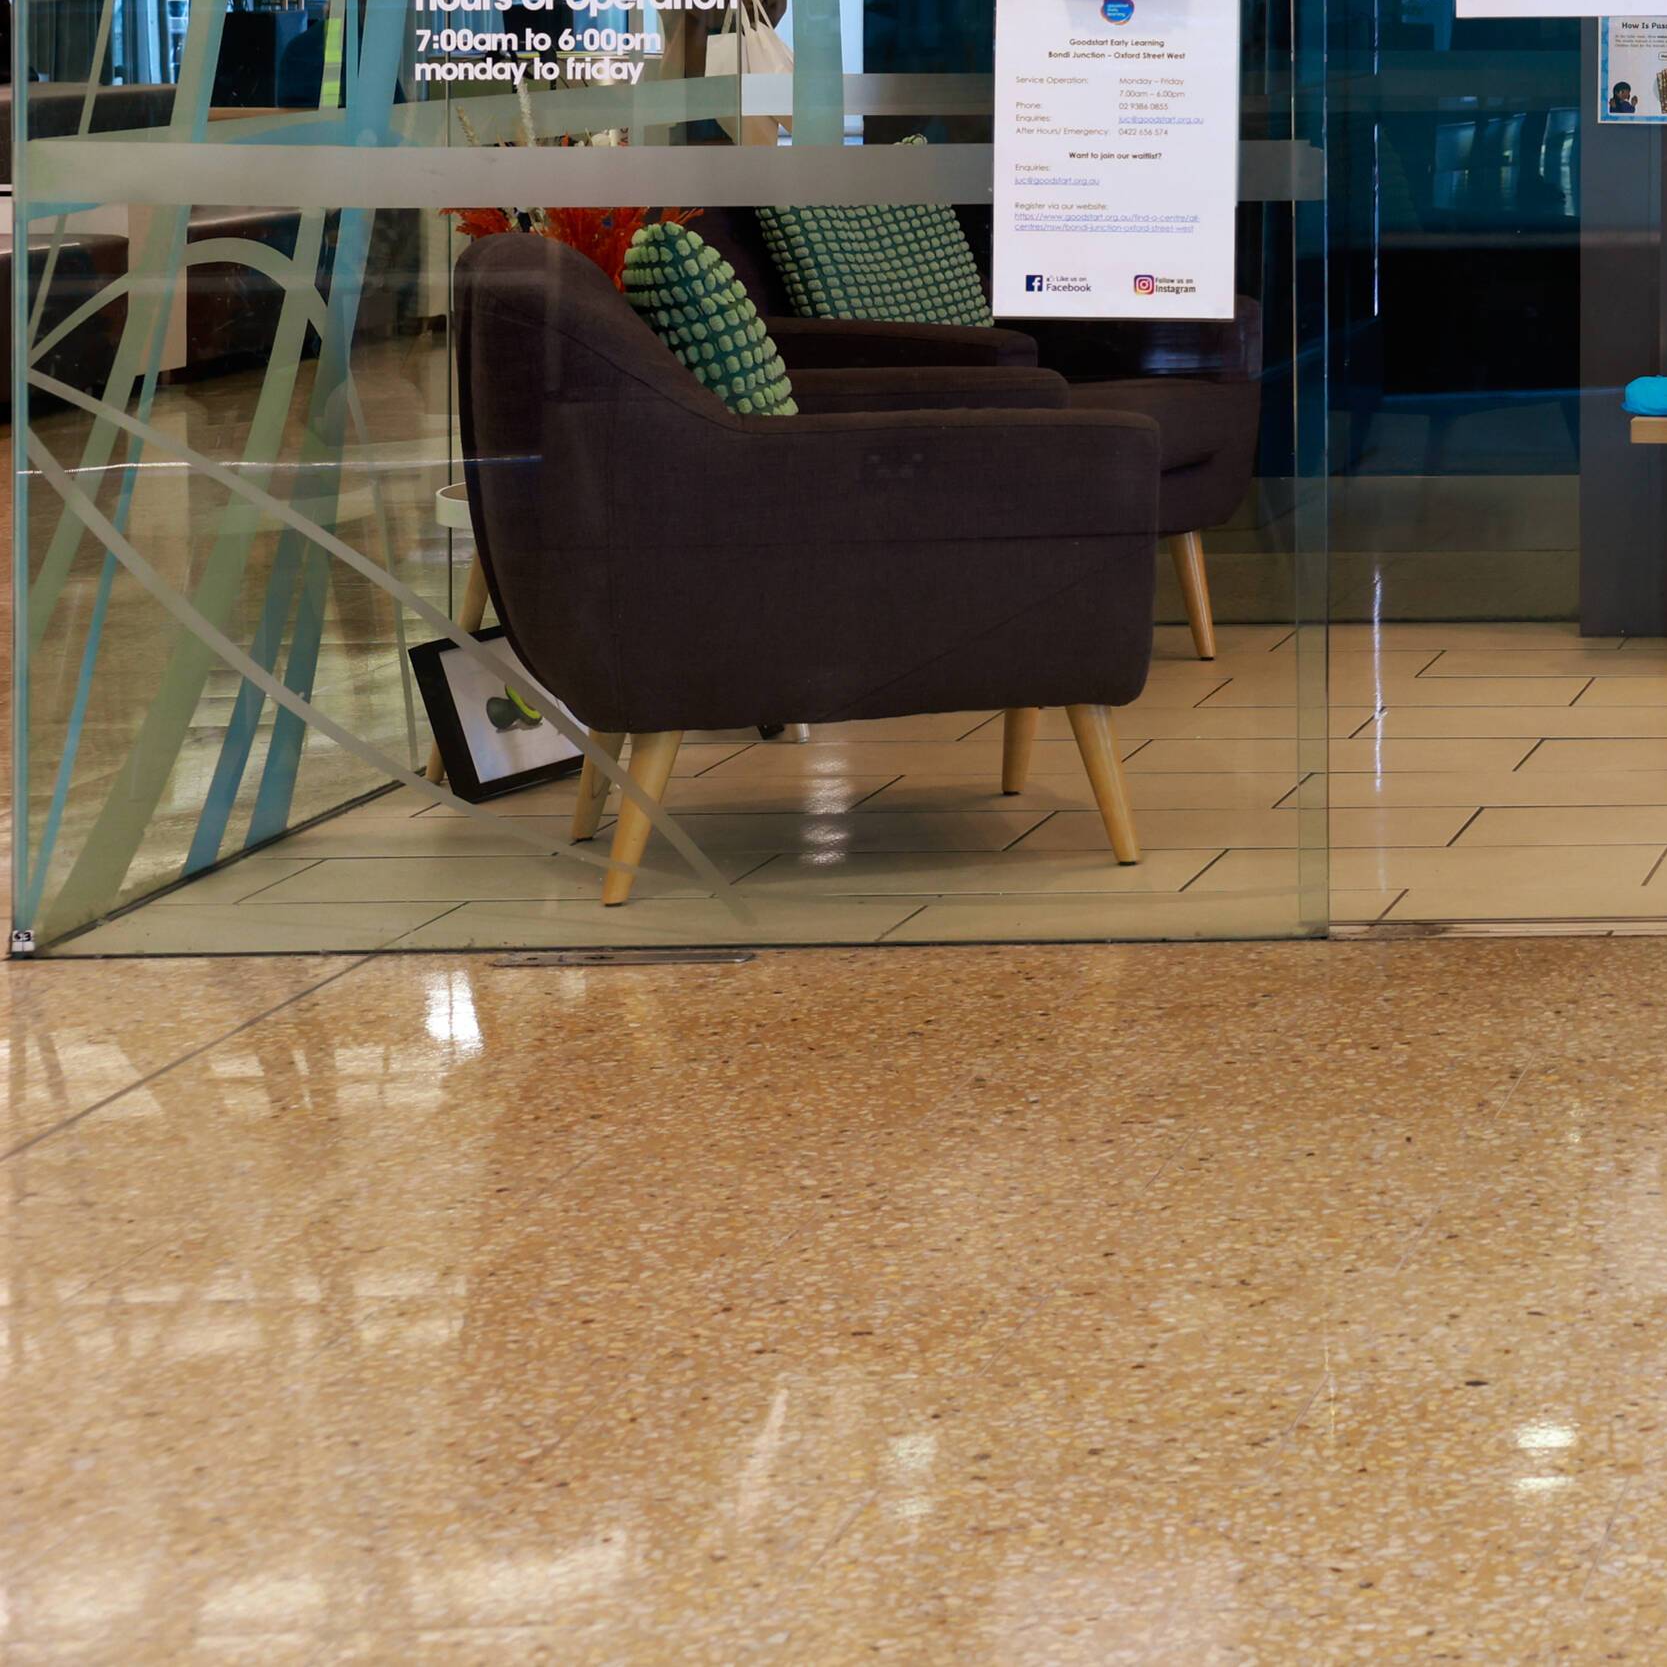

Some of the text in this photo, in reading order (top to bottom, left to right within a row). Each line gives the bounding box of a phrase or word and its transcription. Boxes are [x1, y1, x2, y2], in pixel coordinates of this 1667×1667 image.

[1622, 21, 1639, 30] How
[416, 30, 518, 52] 7:00am
[525, 28, 550, 52] to
[1069, 38, 1165, 48] Goodstart Early Learning
[1048, 51, 1186, 60] Bondi Junction Oxford Street West
[415, 56, 644, 84] monday to friday
[1016, 76, 1045, 84] Service
[1069, 152, 1088, 160] Want
[1090, 152, 1099, 160] to
[1100, 152, 1113, 161] join
[1015, 202, 1046, 211] Register
[1046, 284, 1092, 292] Facebook
[1155, 285, 1196, 295] Instagram
